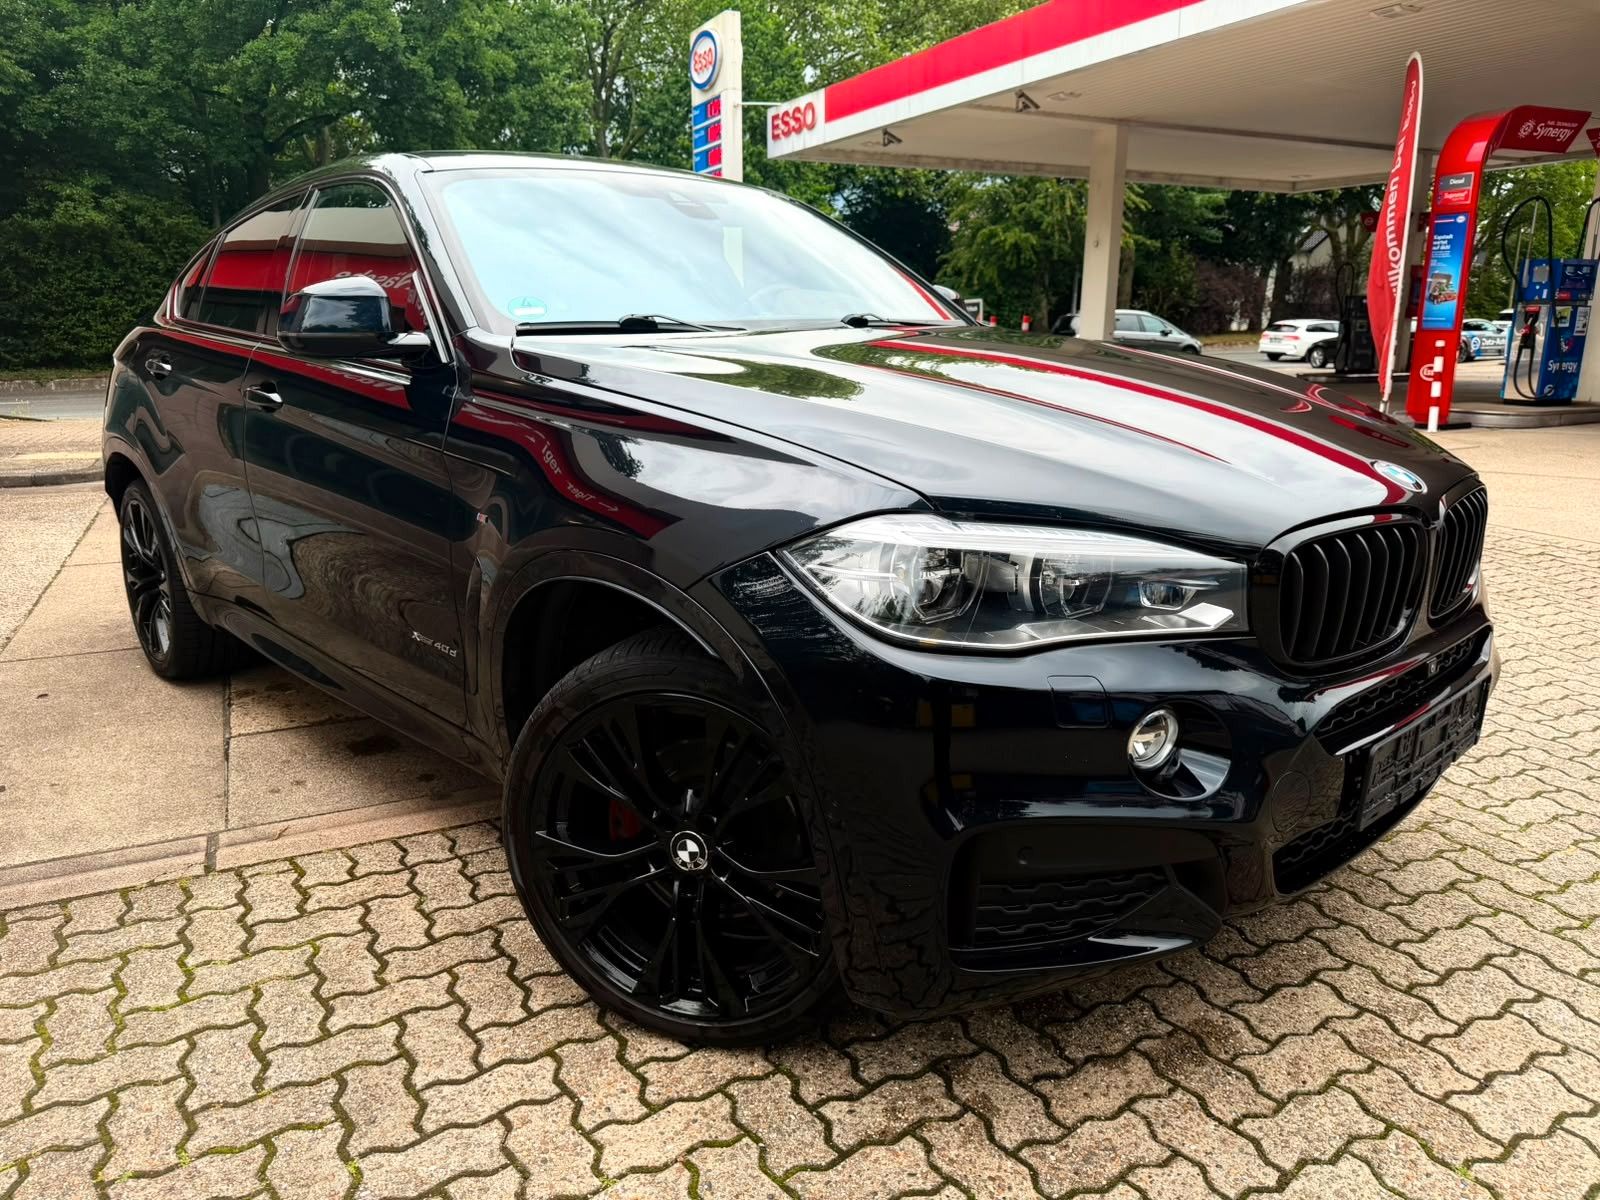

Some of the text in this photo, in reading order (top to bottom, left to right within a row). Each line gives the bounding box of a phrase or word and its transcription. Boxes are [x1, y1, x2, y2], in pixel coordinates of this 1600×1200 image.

[771, 102, 816, 141] ESSO
[1533, 123, 1574, 142] Synergy
[1386, 176, 1403, 296] llkommen
